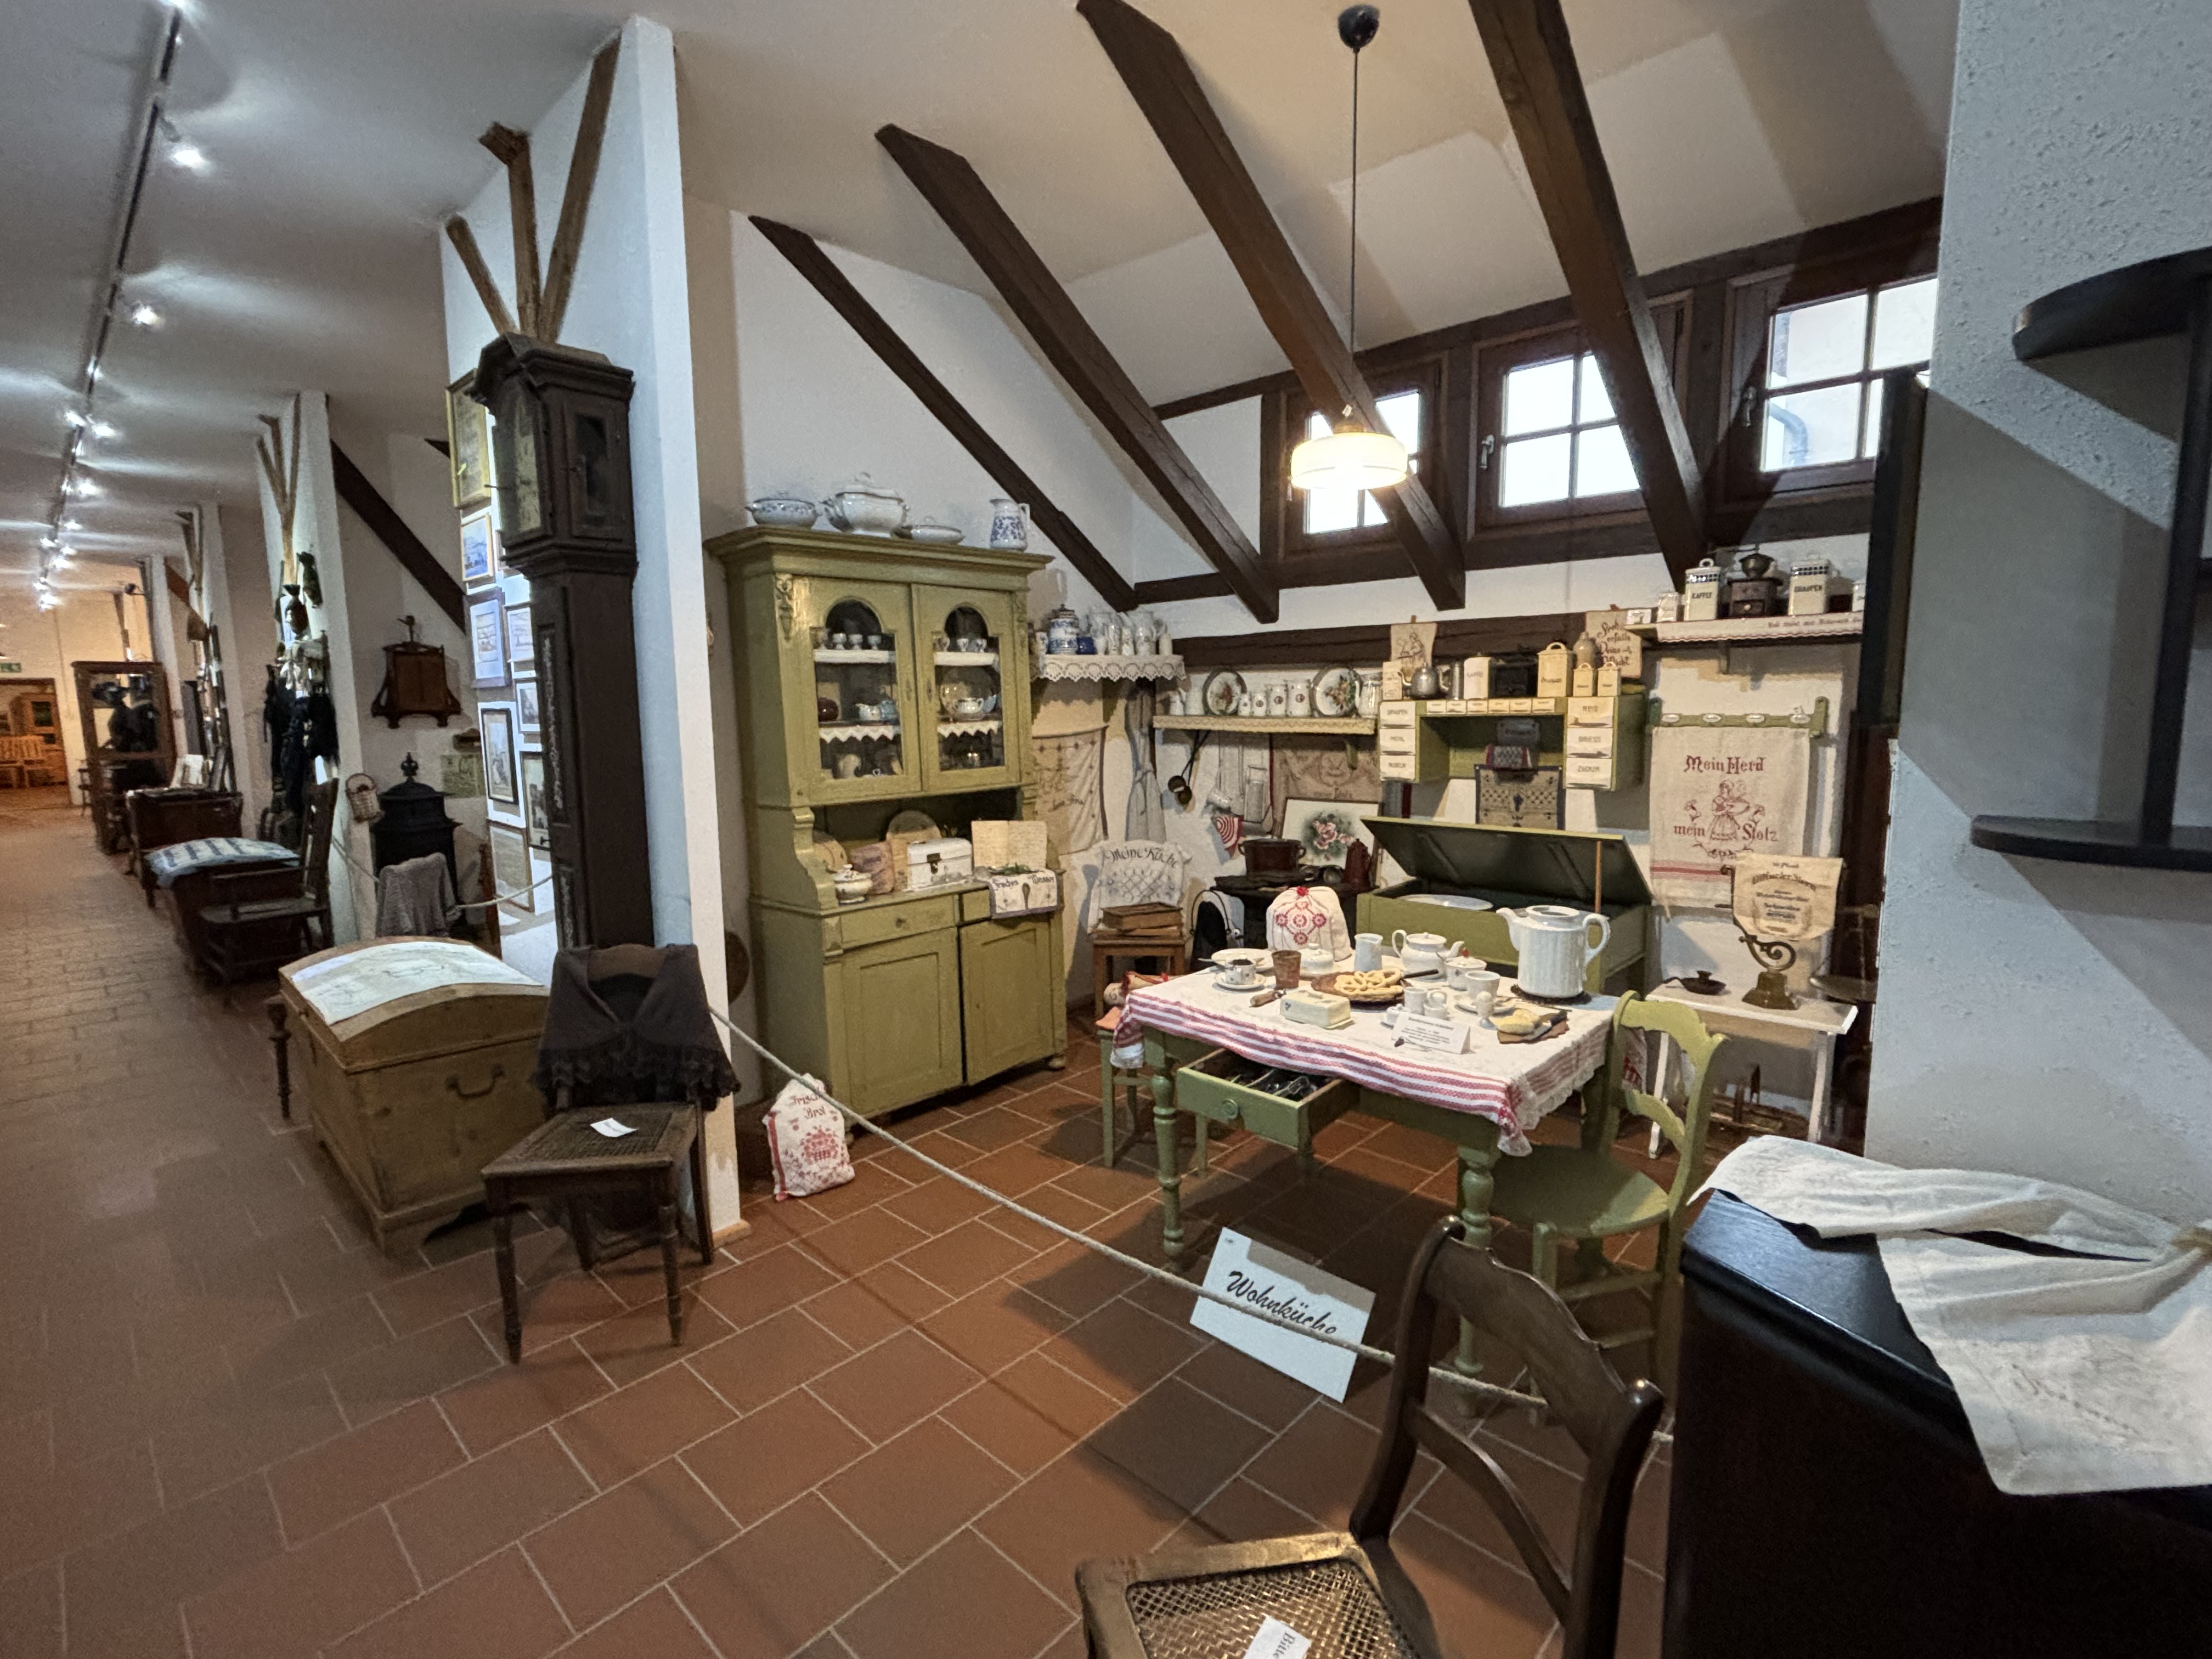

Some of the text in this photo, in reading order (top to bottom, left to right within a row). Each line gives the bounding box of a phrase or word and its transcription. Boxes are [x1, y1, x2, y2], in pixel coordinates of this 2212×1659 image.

[1684, 755, 1767, 775] Mein Herd
[1673, 823, 1780, 842] mein Stolz
[1227, 1270, 1337, 1334] Wohnküche
[1272, 1631, 1296, 1659] Bitte
